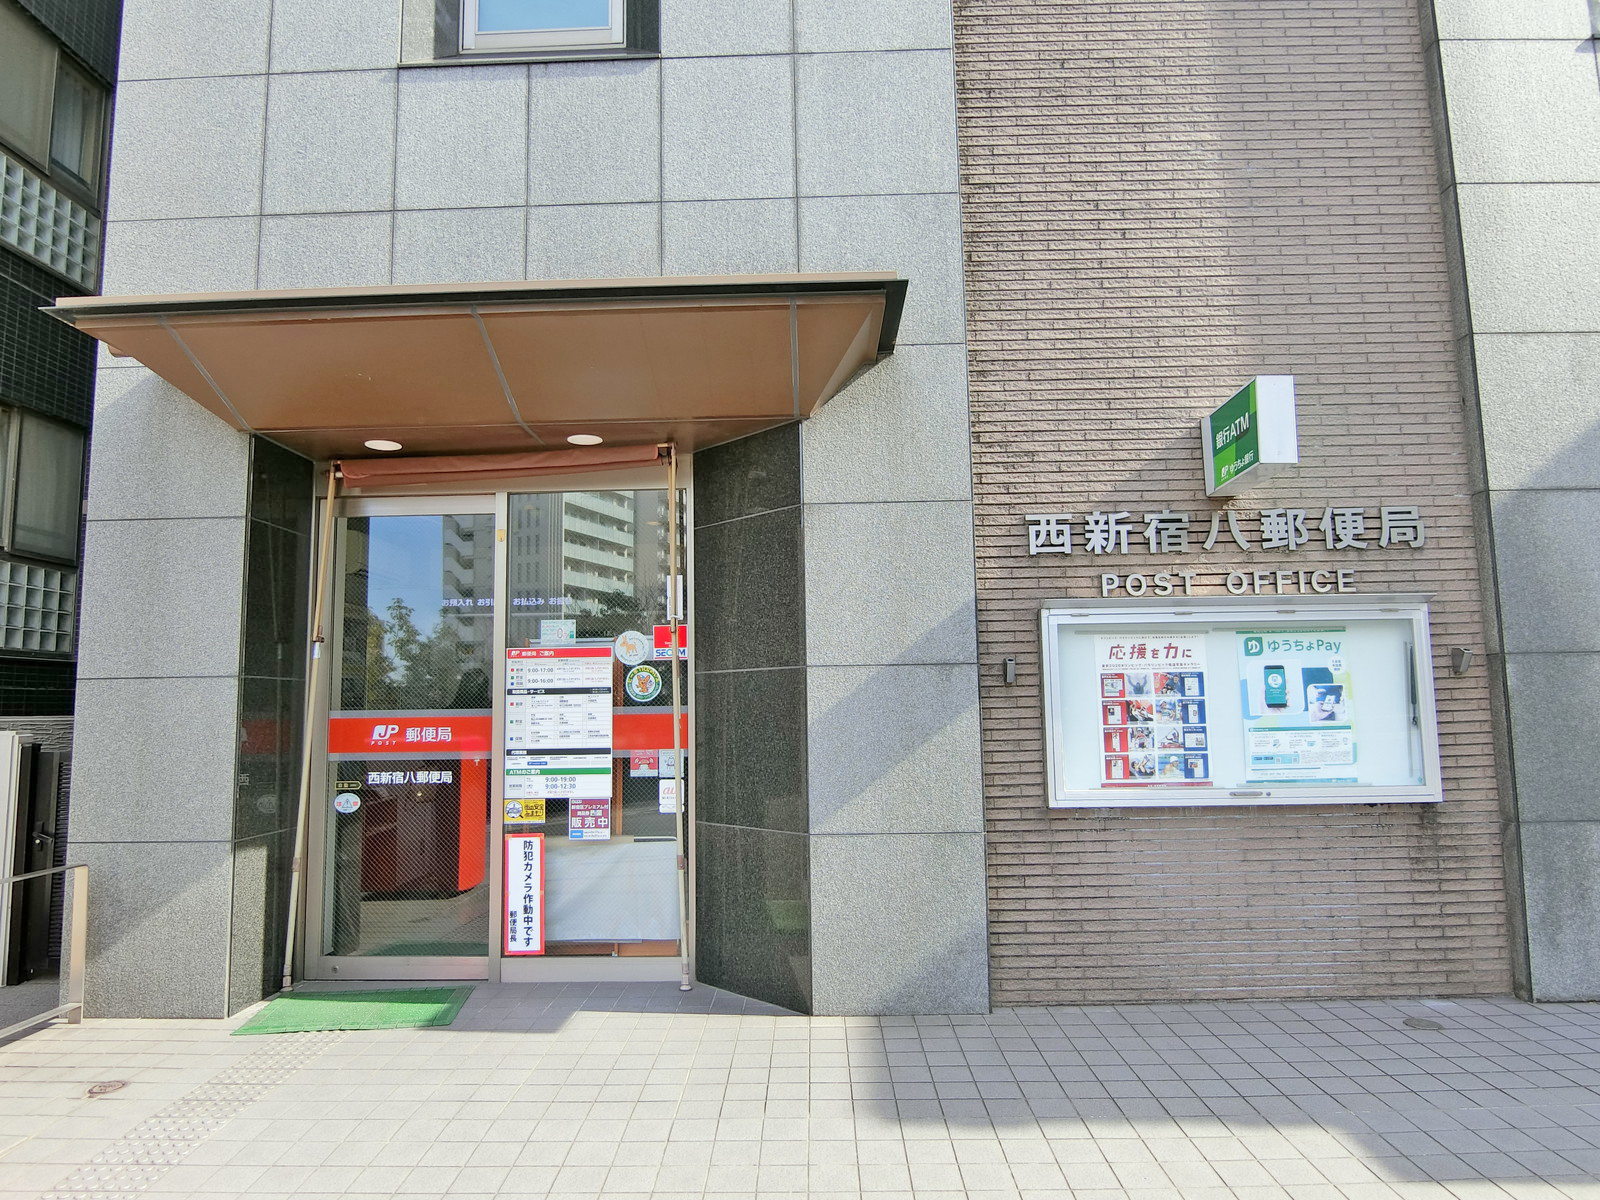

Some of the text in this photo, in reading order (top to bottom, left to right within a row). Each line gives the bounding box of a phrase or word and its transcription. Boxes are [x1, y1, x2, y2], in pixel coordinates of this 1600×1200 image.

[1215, 412, 1250, 450] 銀行ATM
[1025, 506, 1426, 555] 西新宿八郵便局
[1101, 569, 1358, 598] POST OFFICE
[655, 648, 686, 657] SECM
[1108, 643, 1192, 660] 応援を力に
[1267, 639, 1342, 654] ゆうちょPay
[405, 727, 452, 742] 郵便局
[367, 771, 453, 784] 西新宿八郵便局
[571, 817, 608, 828] 販売中
[523, 840, 534, 946] 防犯カメラ作動中です
[509, 910, 517, 942] 郵便局長
